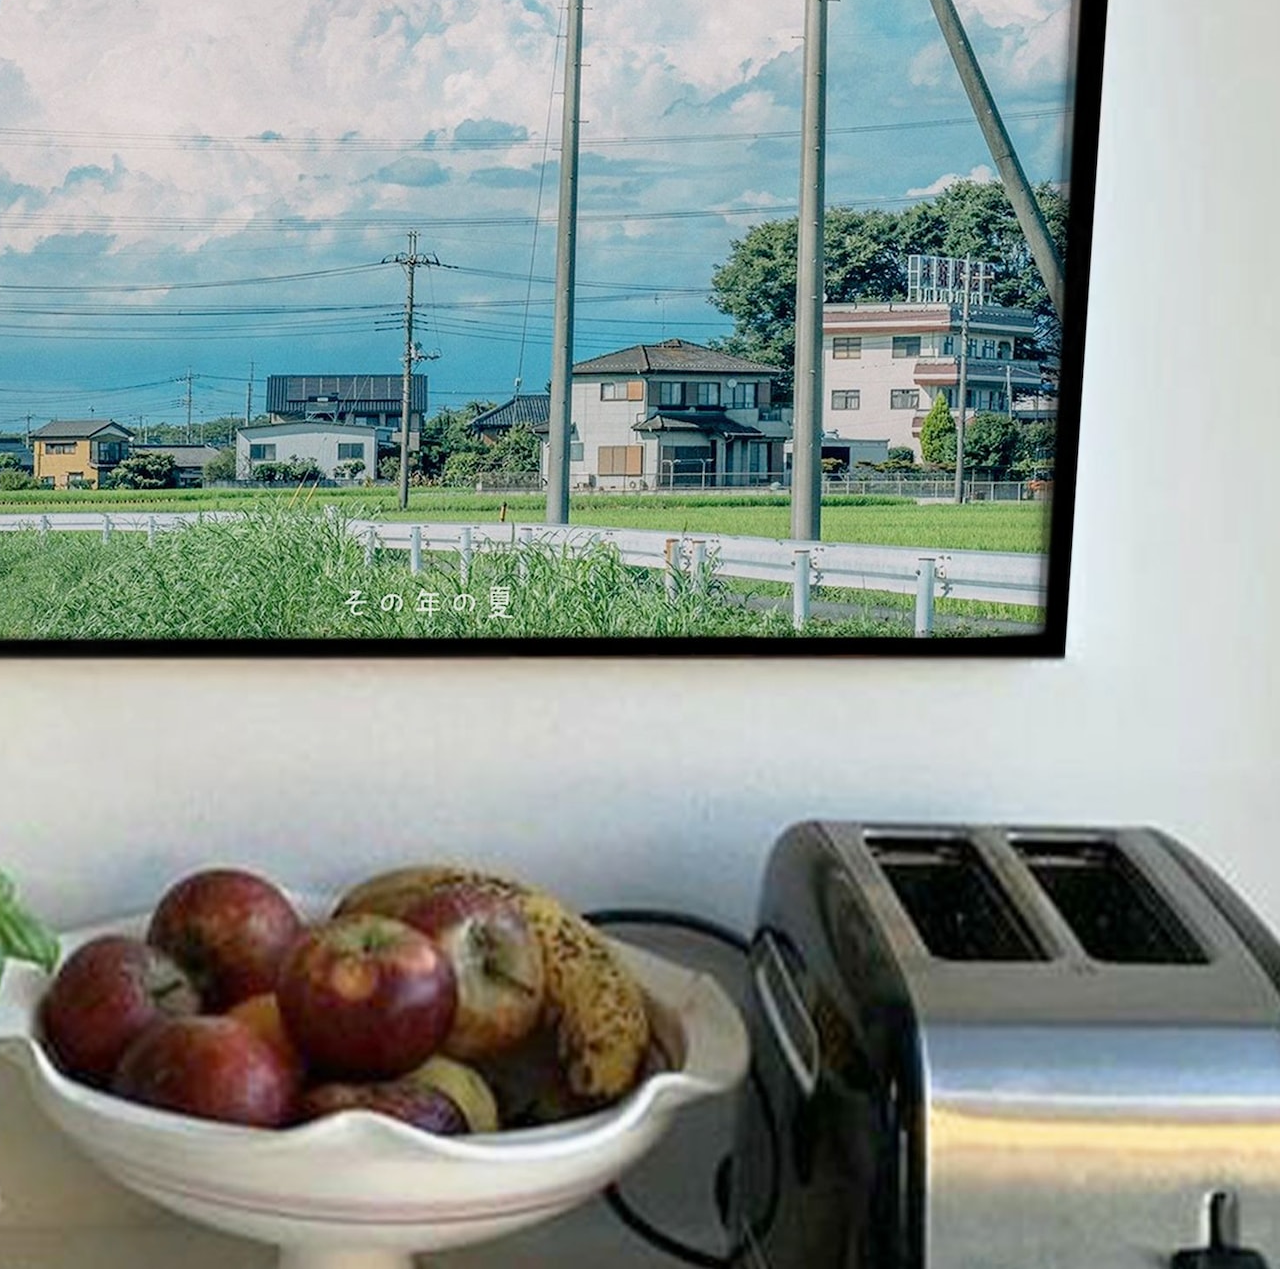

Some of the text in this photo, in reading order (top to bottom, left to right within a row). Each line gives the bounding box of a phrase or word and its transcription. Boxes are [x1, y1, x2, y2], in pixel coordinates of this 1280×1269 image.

[344, 585, 514, 619] その年の夏
